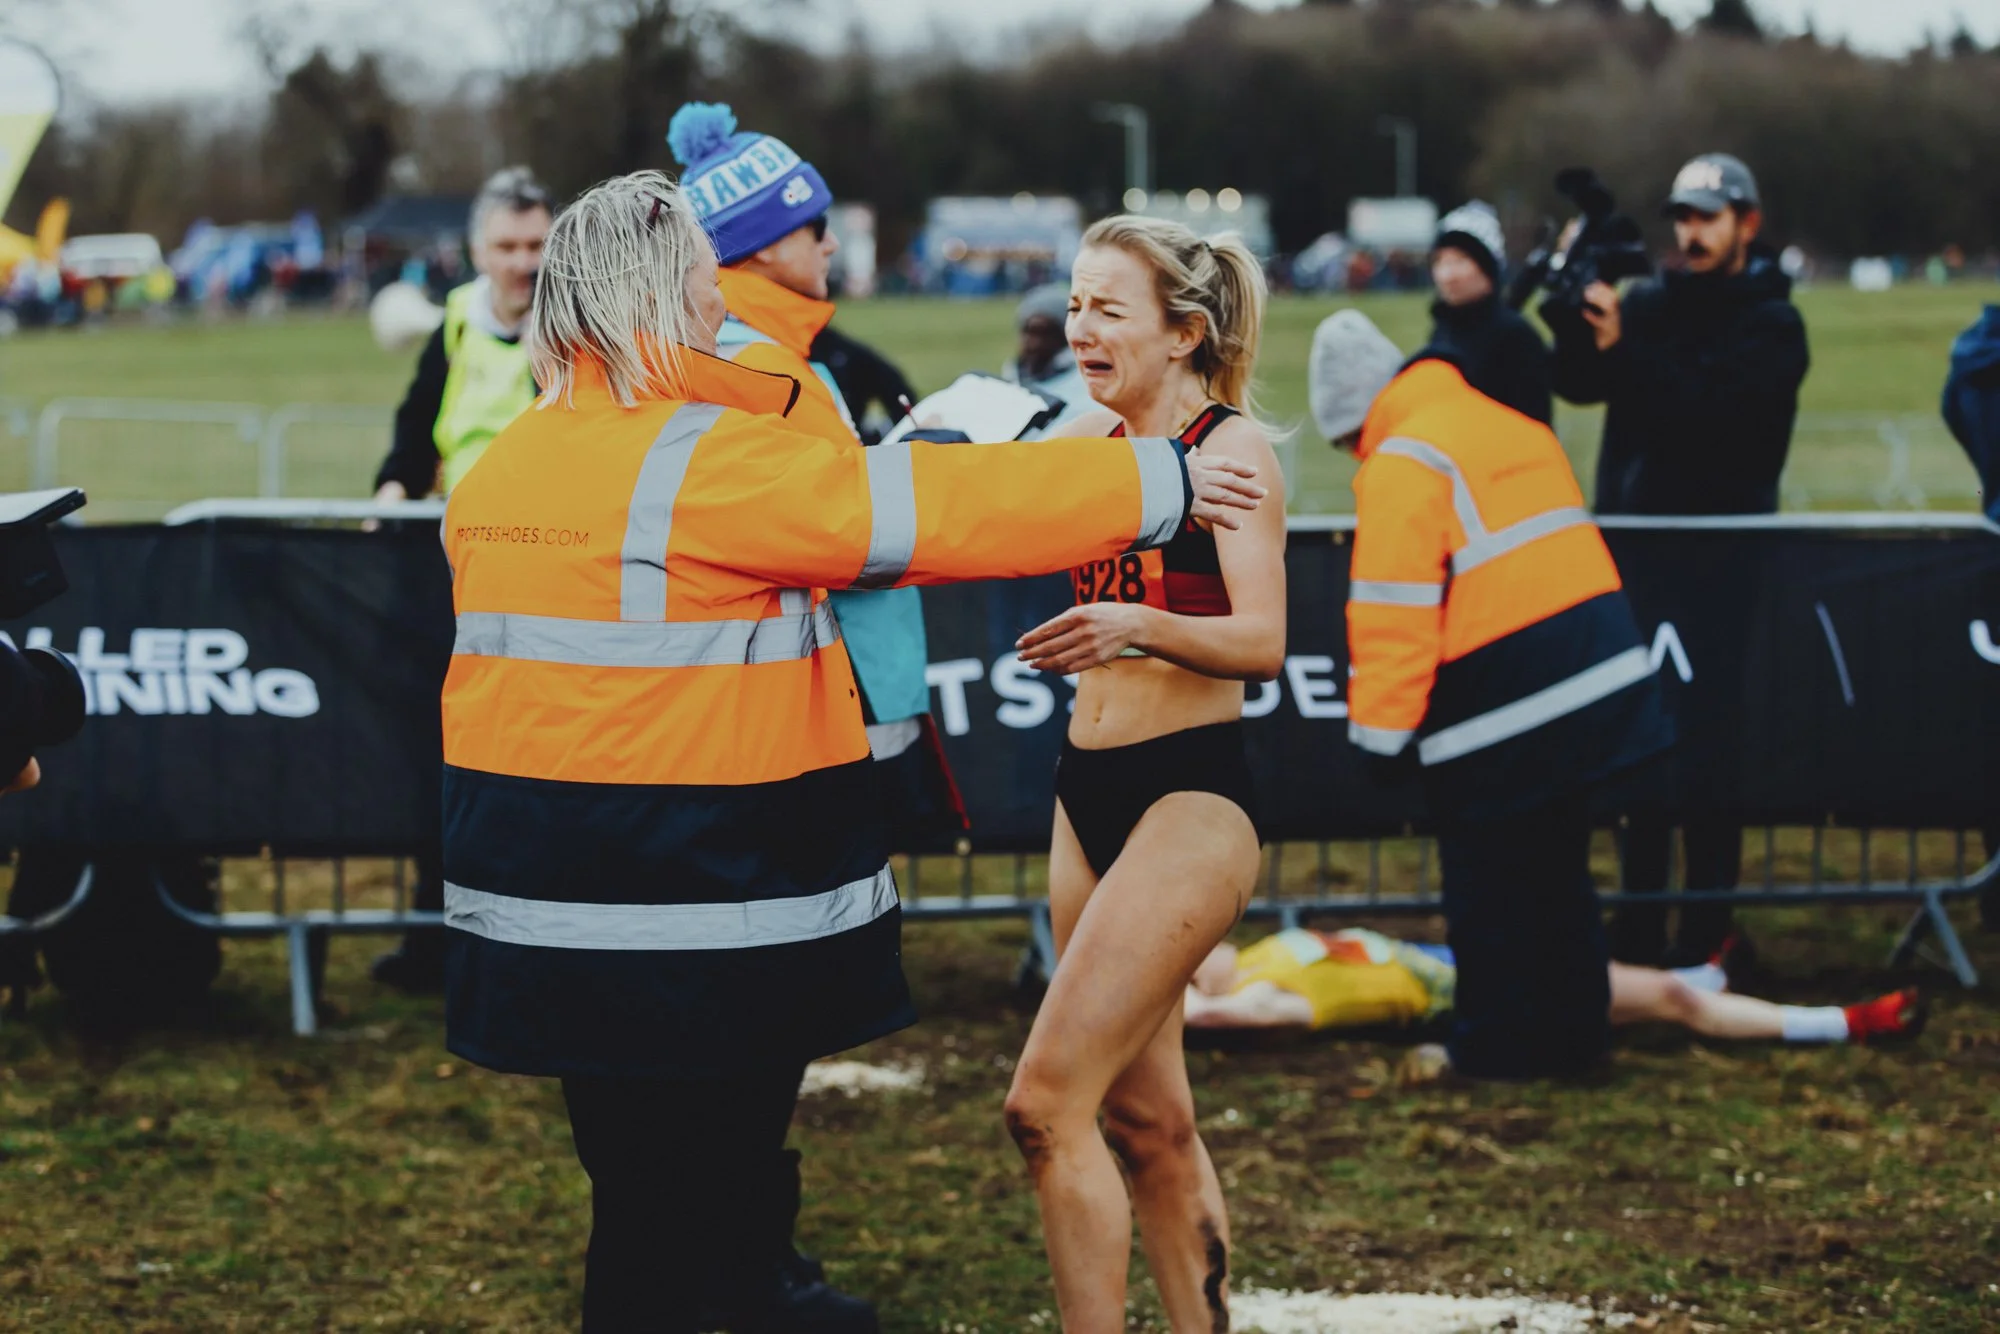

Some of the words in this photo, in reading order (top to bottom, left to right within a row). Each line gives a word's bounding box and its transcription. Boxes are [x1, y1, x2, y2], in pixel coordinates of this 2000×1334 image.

[1078, 553, 1146, 604] 928
[0, 626, 249, 673] LED
[85, 667, 320, 718] NING
